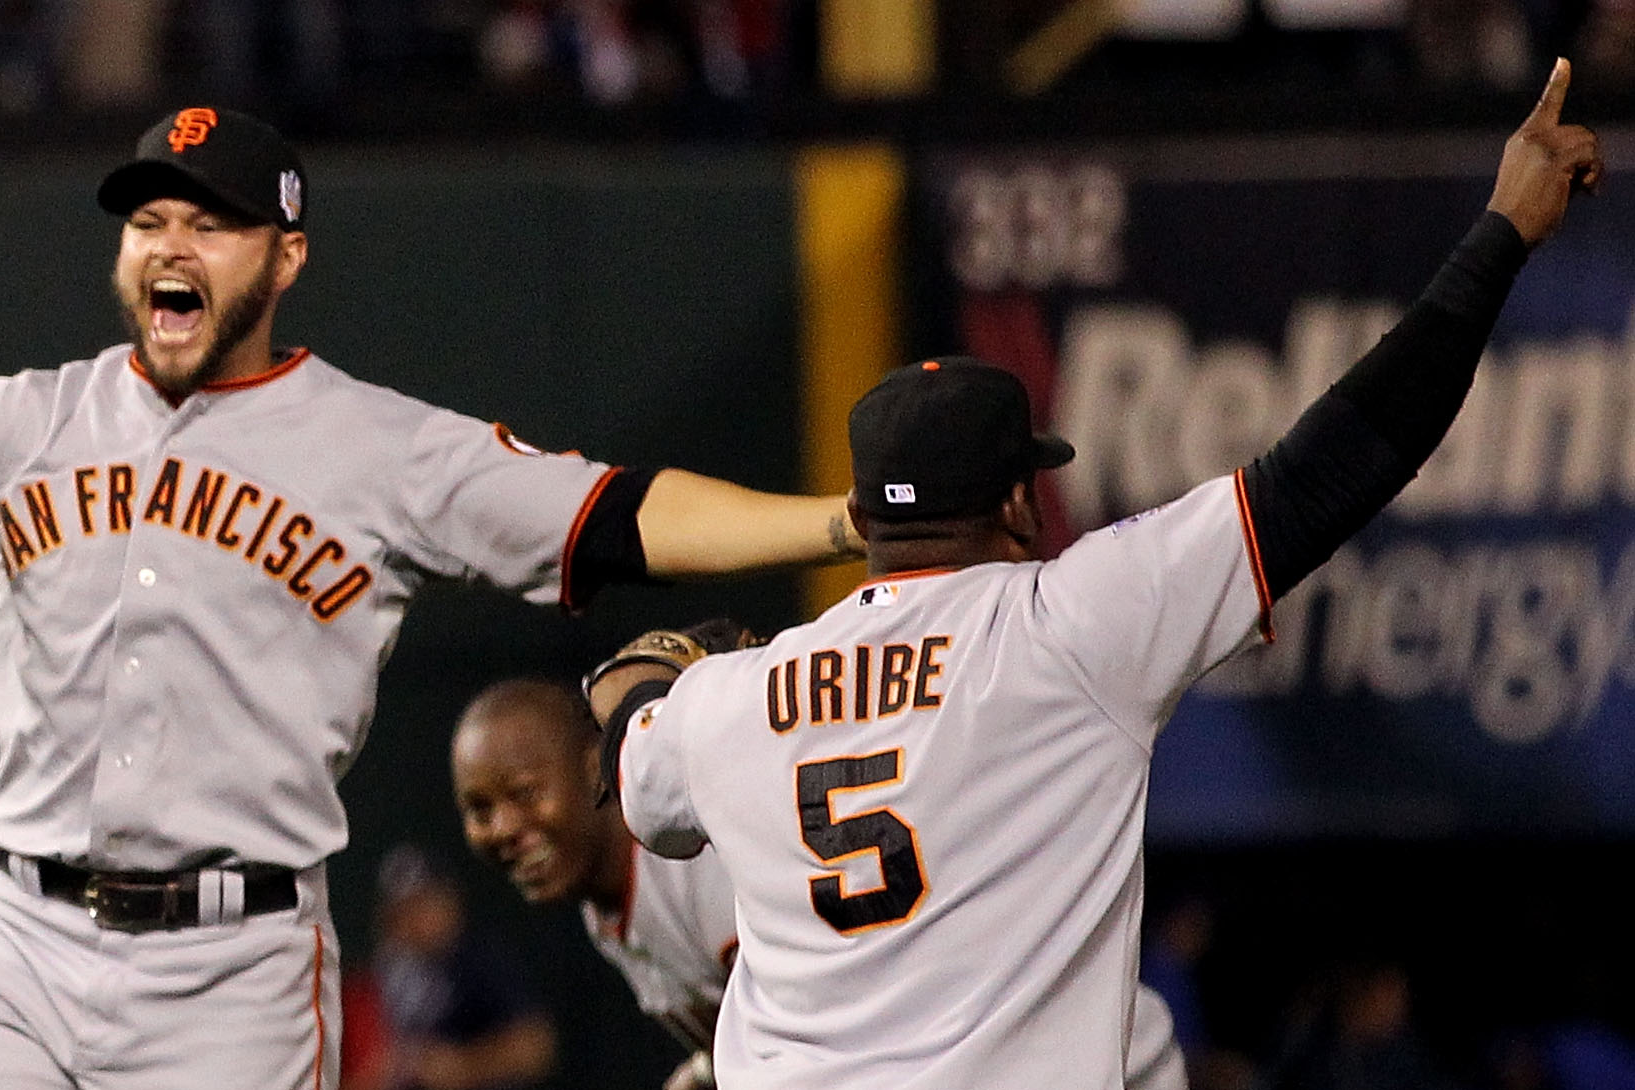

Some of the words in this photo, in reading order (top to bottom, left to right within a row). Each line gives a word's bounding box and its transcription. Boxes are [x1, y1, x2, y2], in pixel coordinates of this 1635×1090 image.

[74, 455, 374, 624] FRANCISCO
[767, 634, 953, 736] URIBE
[1197, 535, 1635, 744] nergy
[794, 746, 930, 937] 5
